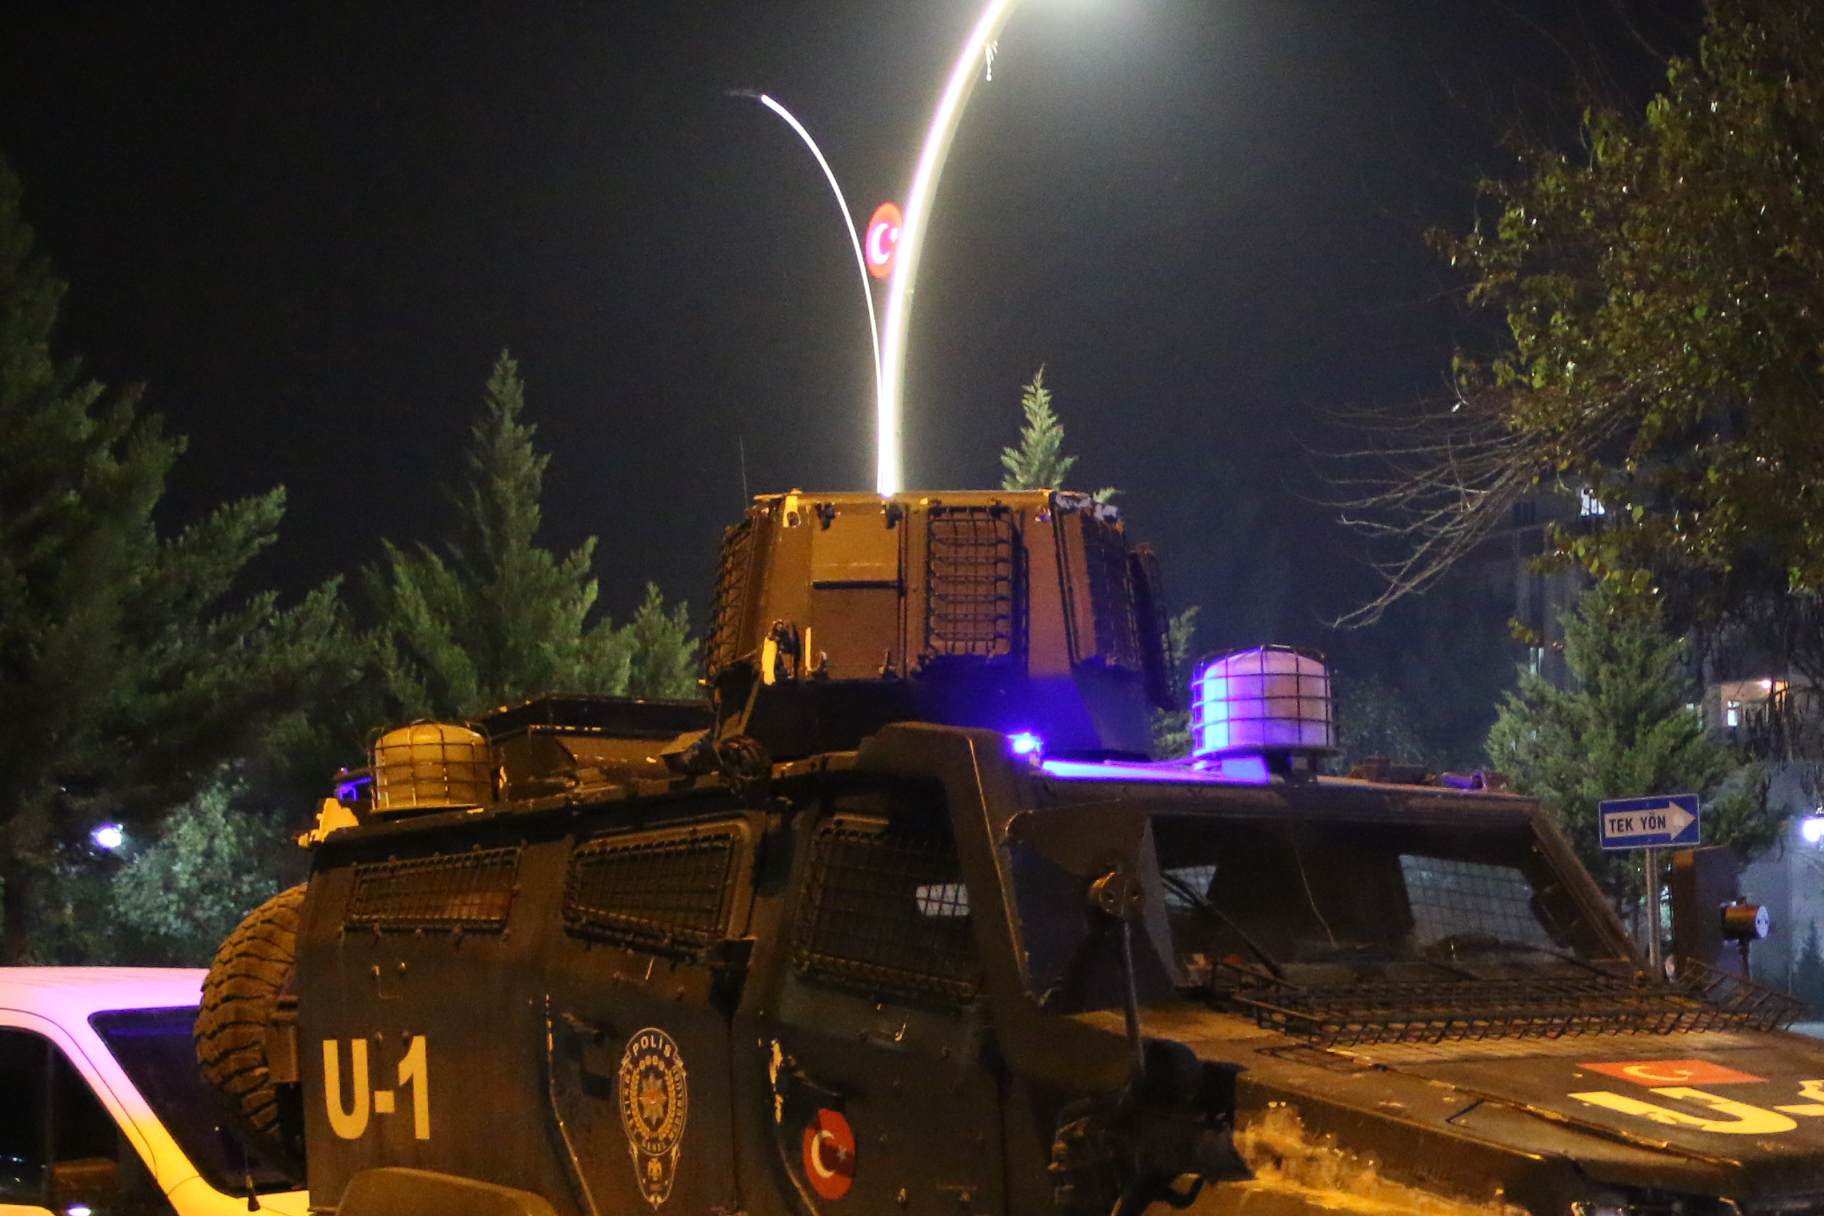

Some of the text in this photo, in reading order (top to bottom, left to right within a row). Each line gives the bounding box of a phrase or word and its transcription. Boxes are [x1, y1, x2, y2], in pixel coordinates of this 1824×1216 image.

[1609, 812, 1666, 833] TEK YÖN
[632, 1034, 672, 1058] POLİS
[322, 1033, 431, 1141] U-1
